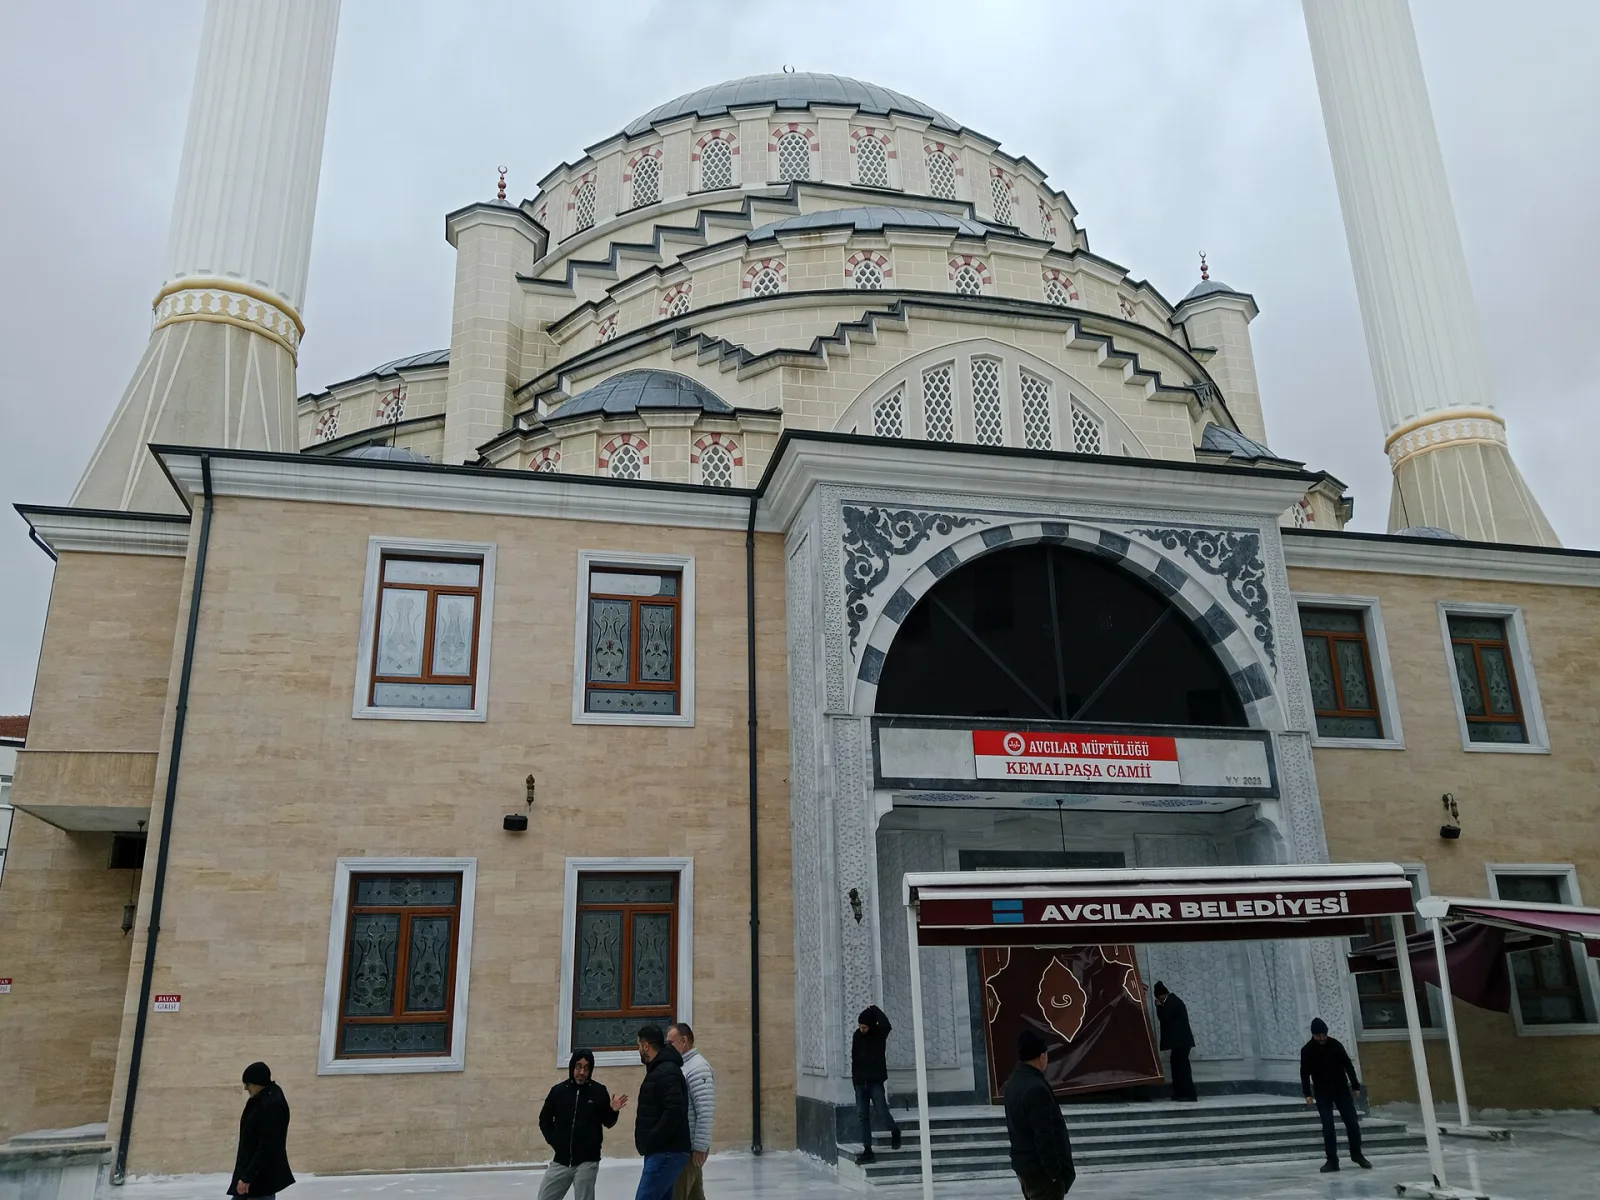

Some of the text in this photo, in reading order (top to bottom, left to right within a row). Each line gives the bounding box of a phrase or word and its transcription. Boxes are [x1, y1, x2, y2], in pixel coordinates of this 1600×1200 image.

[1029, 740, 1149, 757] AVCILAR MÜFTÜLÜĞÜ
[1006, 761, 1152, 780] KEMALPAŞA CAMİİ
[1242, 776, 1262, 785] 2023
[1041, 891, 1349, 921] AVCILAR BELEDİYESİ
